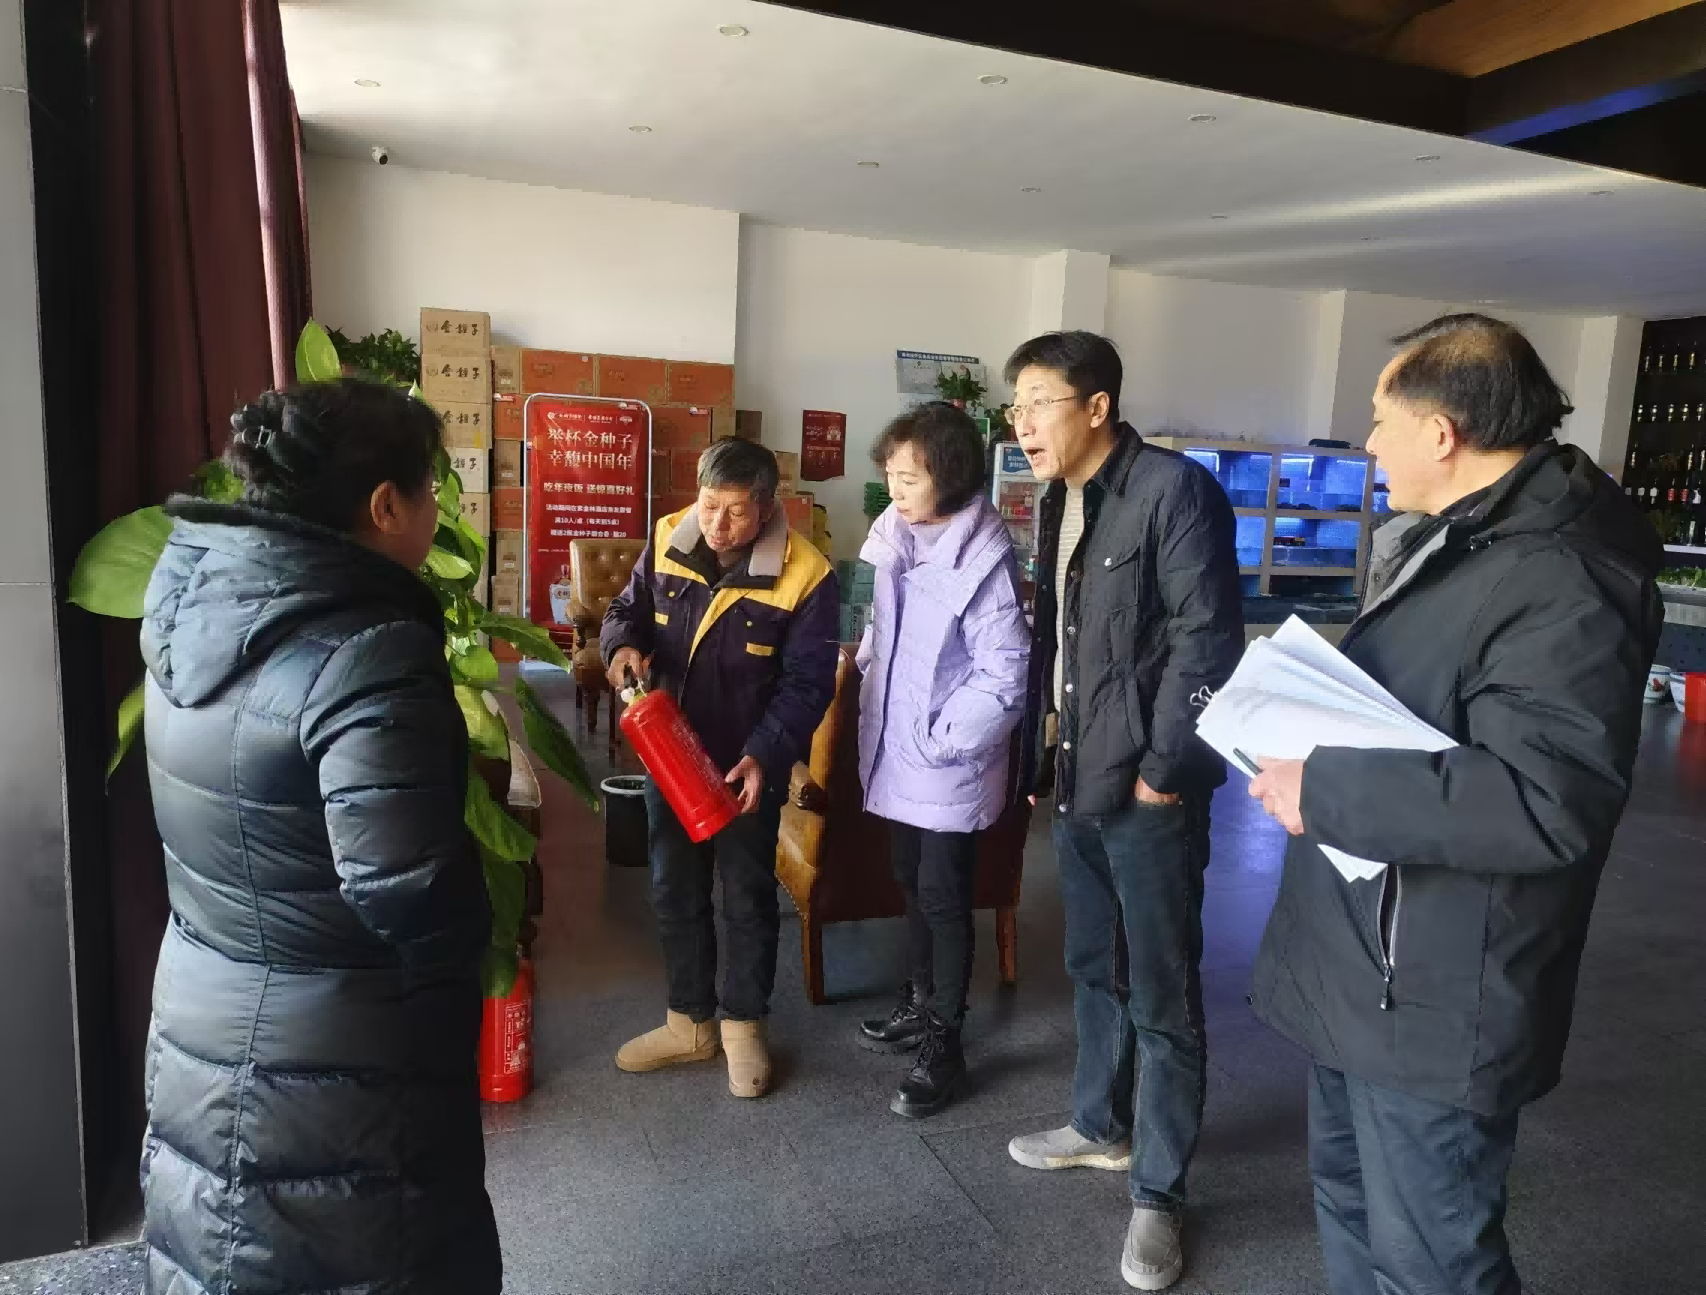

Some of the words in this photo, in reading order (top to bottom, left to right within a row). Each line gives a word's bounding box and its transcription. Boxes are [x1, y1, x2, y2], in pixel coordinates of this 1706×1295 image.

[547, 449, 632, 470] 幸馥中国年
[543, 482, 583, 493] 吃年夜饭
[587, 484, 635, 495] 送惊喜好礼
